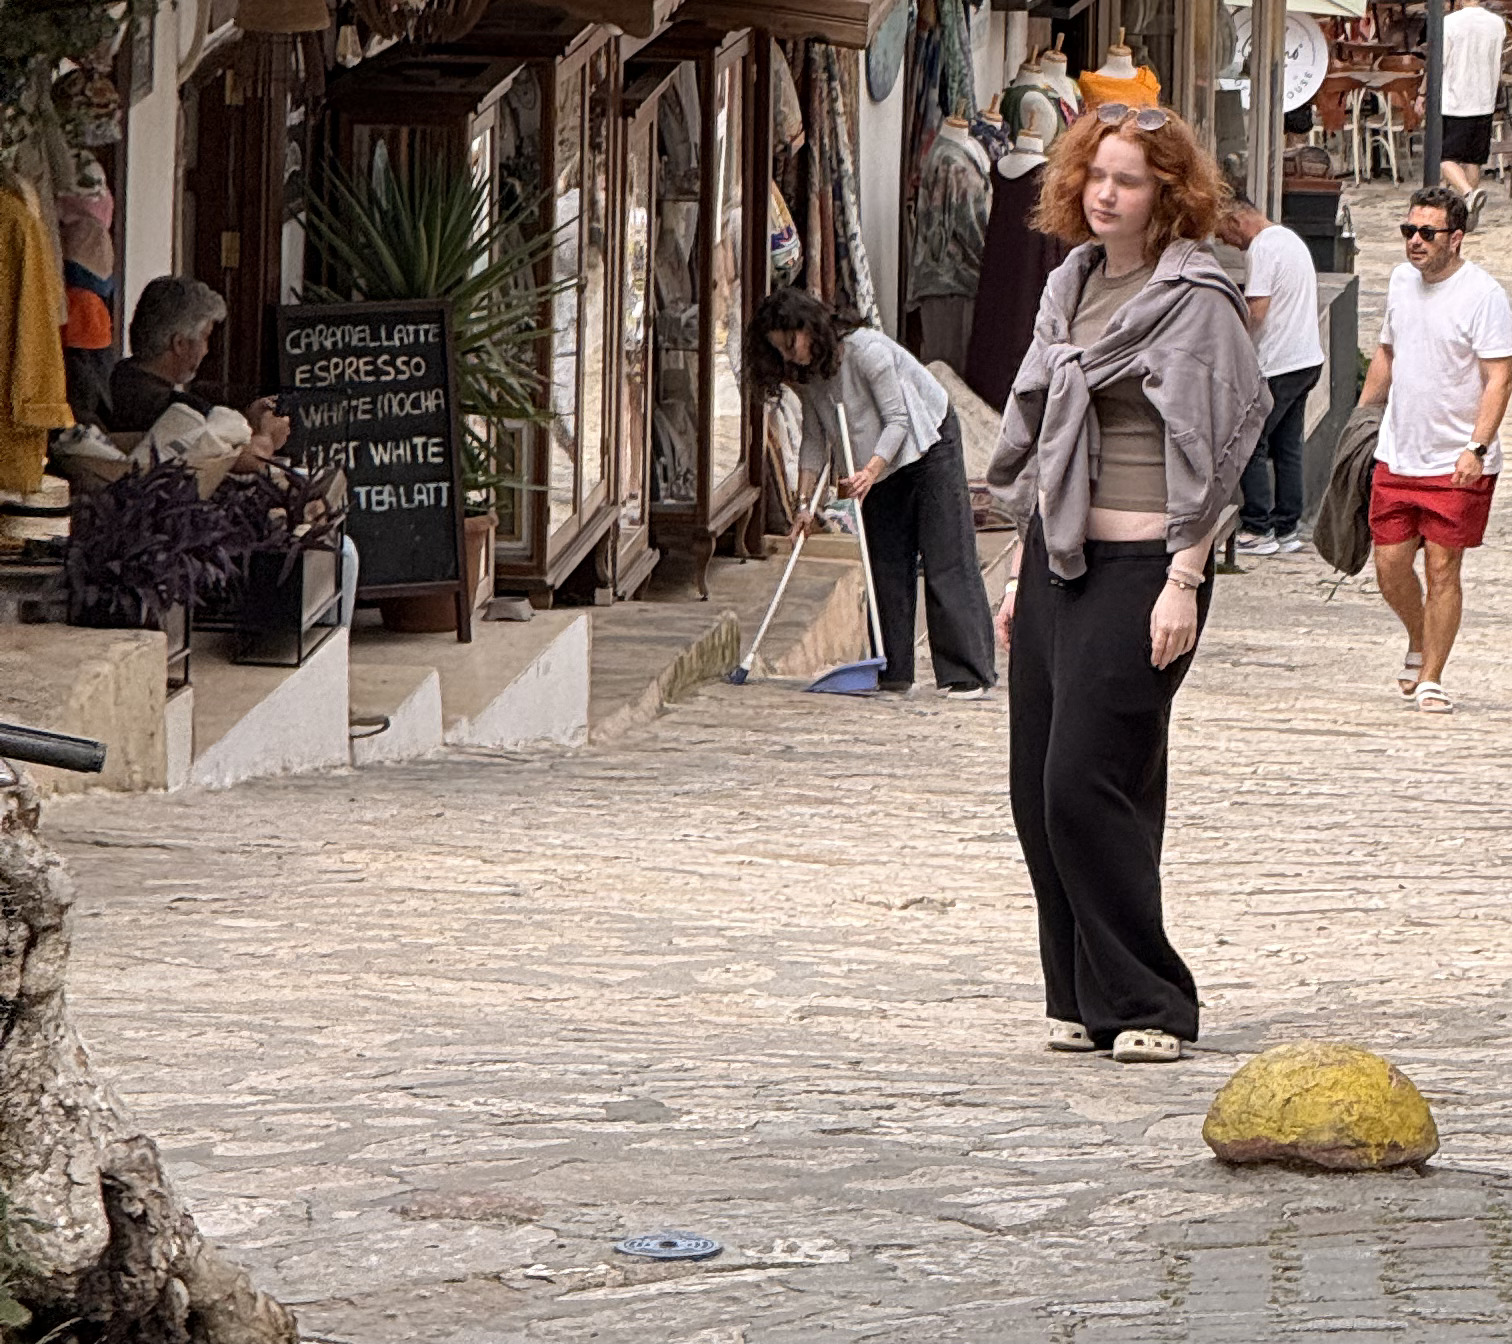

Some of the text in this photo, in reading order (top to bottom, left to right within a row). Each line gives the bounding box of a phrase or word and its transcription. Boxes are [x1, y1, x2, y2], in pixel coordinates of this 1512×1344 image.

[1286, 71, 1314, 100] OUSE
[285, 323, 441, 355] CARAMEL LATTE
[295, 355, 426, 388] ESPRESSO
[369, 436, 445, 466] WHITE
